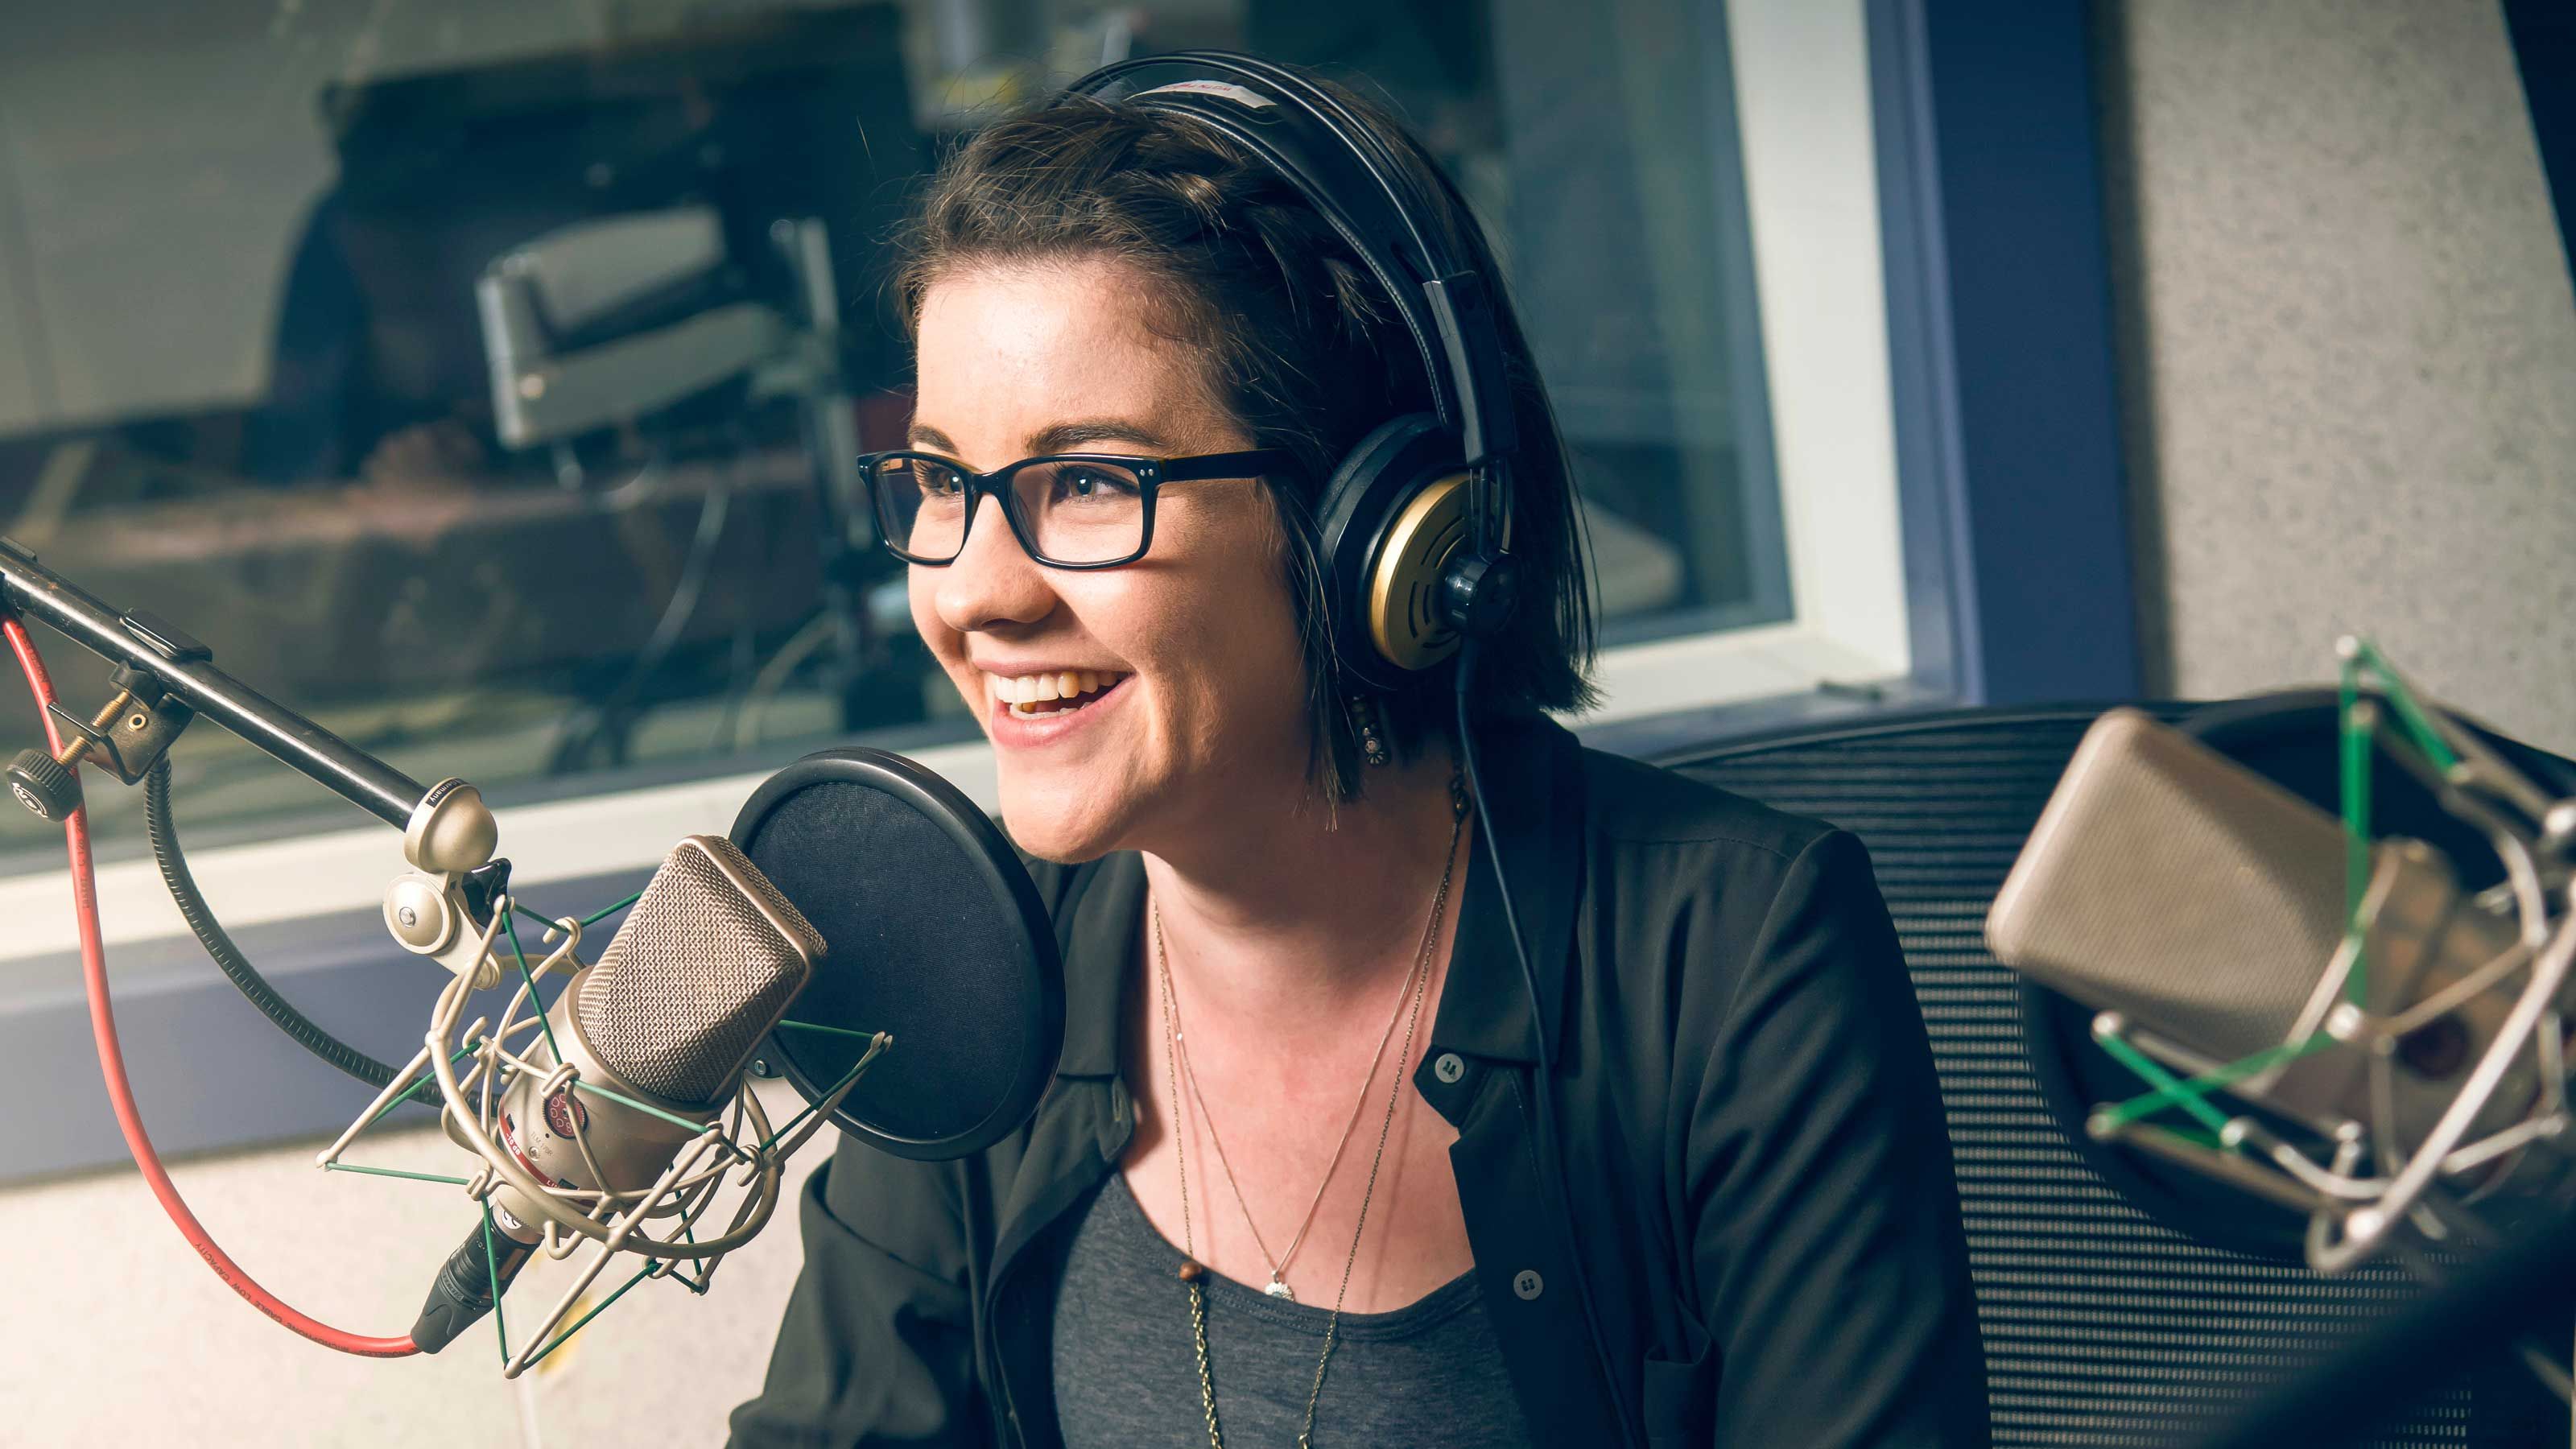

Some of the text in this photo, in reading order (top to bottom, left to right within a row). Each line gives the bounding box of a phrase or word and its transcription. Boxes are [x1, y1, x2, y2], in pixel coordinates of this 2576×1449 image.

[512, 1146, 521, 1156] dB
[195, 1243, 230, 1282] CAPACITY
[231, 1283, 251, 1301] LOW
[254, 1300, 283, 1323] CABLE
